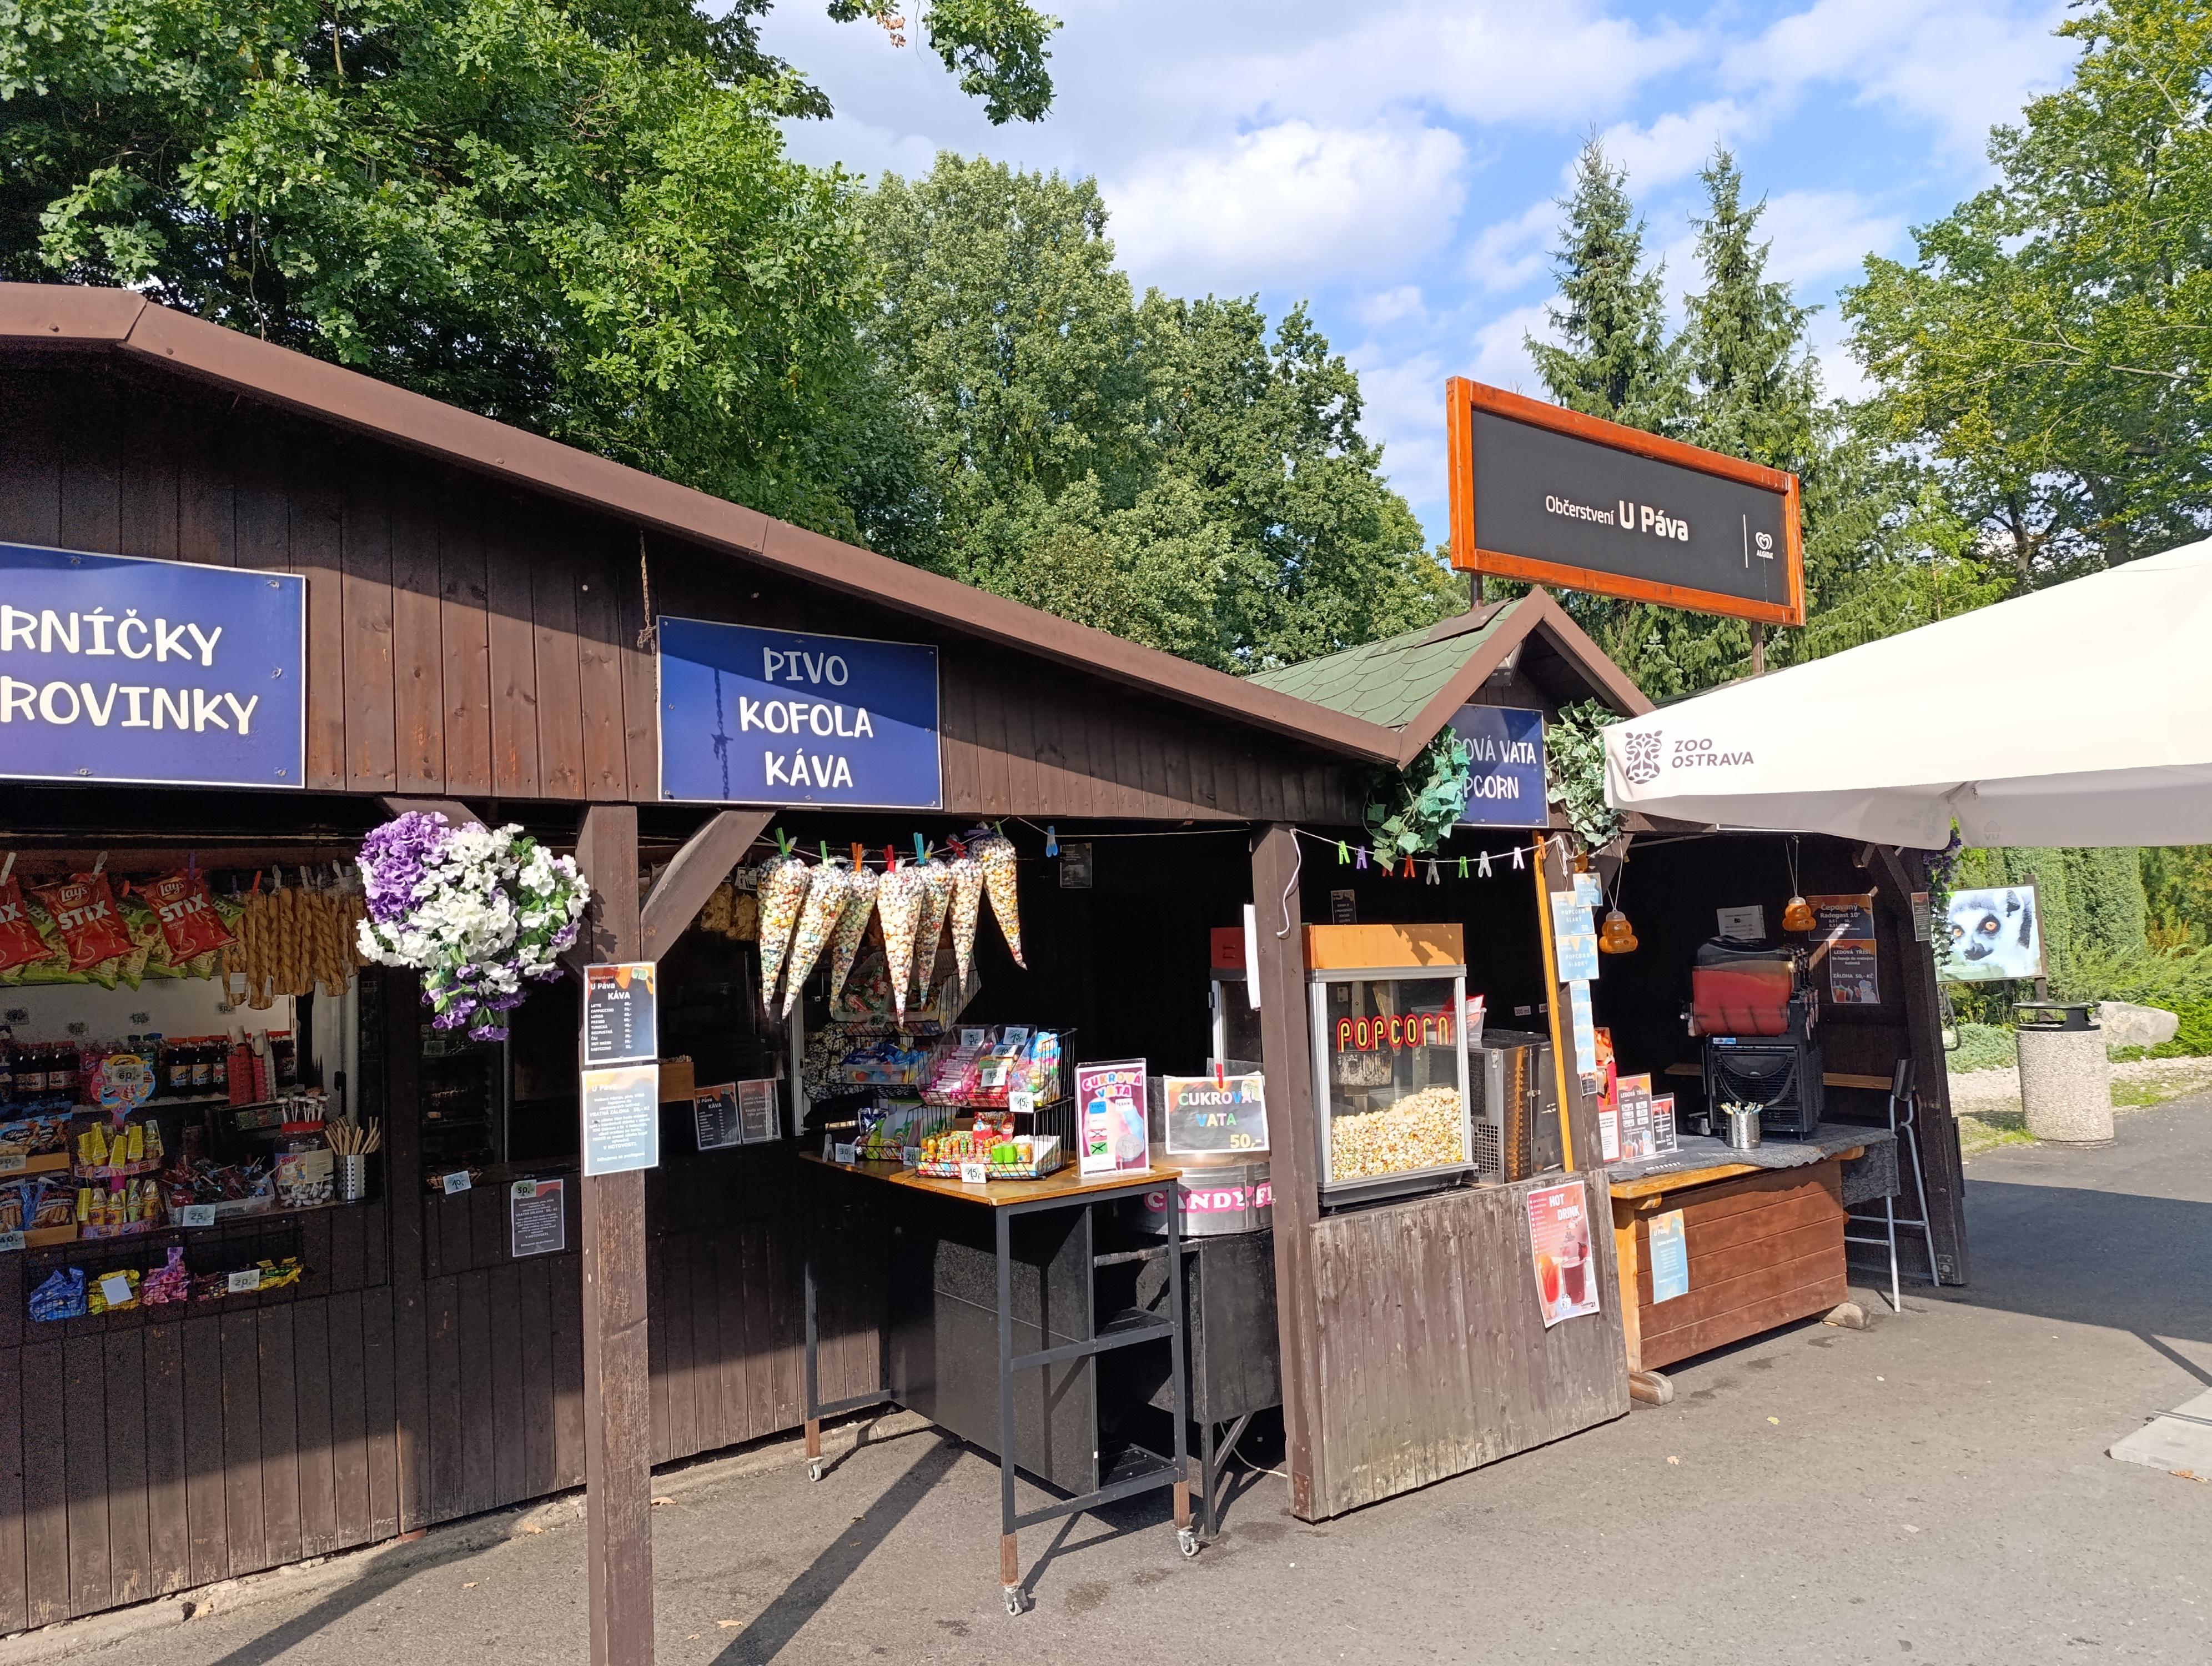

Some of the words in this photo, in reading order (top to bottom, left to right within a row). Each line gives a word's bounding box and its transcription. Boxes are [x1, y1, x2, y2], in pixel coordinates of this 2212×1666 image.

[1545, 495, 1614, 525] Občerstvení
[1618, 500, 1635, 530] U
[1641, 504, 1688, 541] Páva
[1756, 550, 1773, 559] ALGIDA
[0, 605, 222, 666] RNÍČKY
[763, 647, 848, 685] PIVO
[0, 675, 258, 735] ROVINKY
[739, 696, 873, 738] KOFOLA
[1500, 740, 1537, 764] VATA
[1674, 738, 1712, 752] ZOO
[765, 748, 853, 788] KÁVA
[1672, 751, 1754, 769] OSTRAVA
[58, 900, 112, 930] STIX
[159, 893, 209, 922] STIX
[1821, 902, 1858, 911] Čepovaný
[597, 981, 615, 990] Páva
[608, 990, 630, 1000] KÁVA
[1336, 1012, 1451, 1053] POPCORN
[1082, 1071, 1143, 1092] CUKROVÁ
[1095, 1084, 1132, 1098] VATA
[1621, 1090, 1635, 1098] LEDOVÁ
[1196, 1113, 1237, 1127] VATA
[1230, 1133, 1262, 1148] 50,-
[1549, 1193, 1565, 1208] HOT
[1557, 1205, 1580, 1221] DRINK
